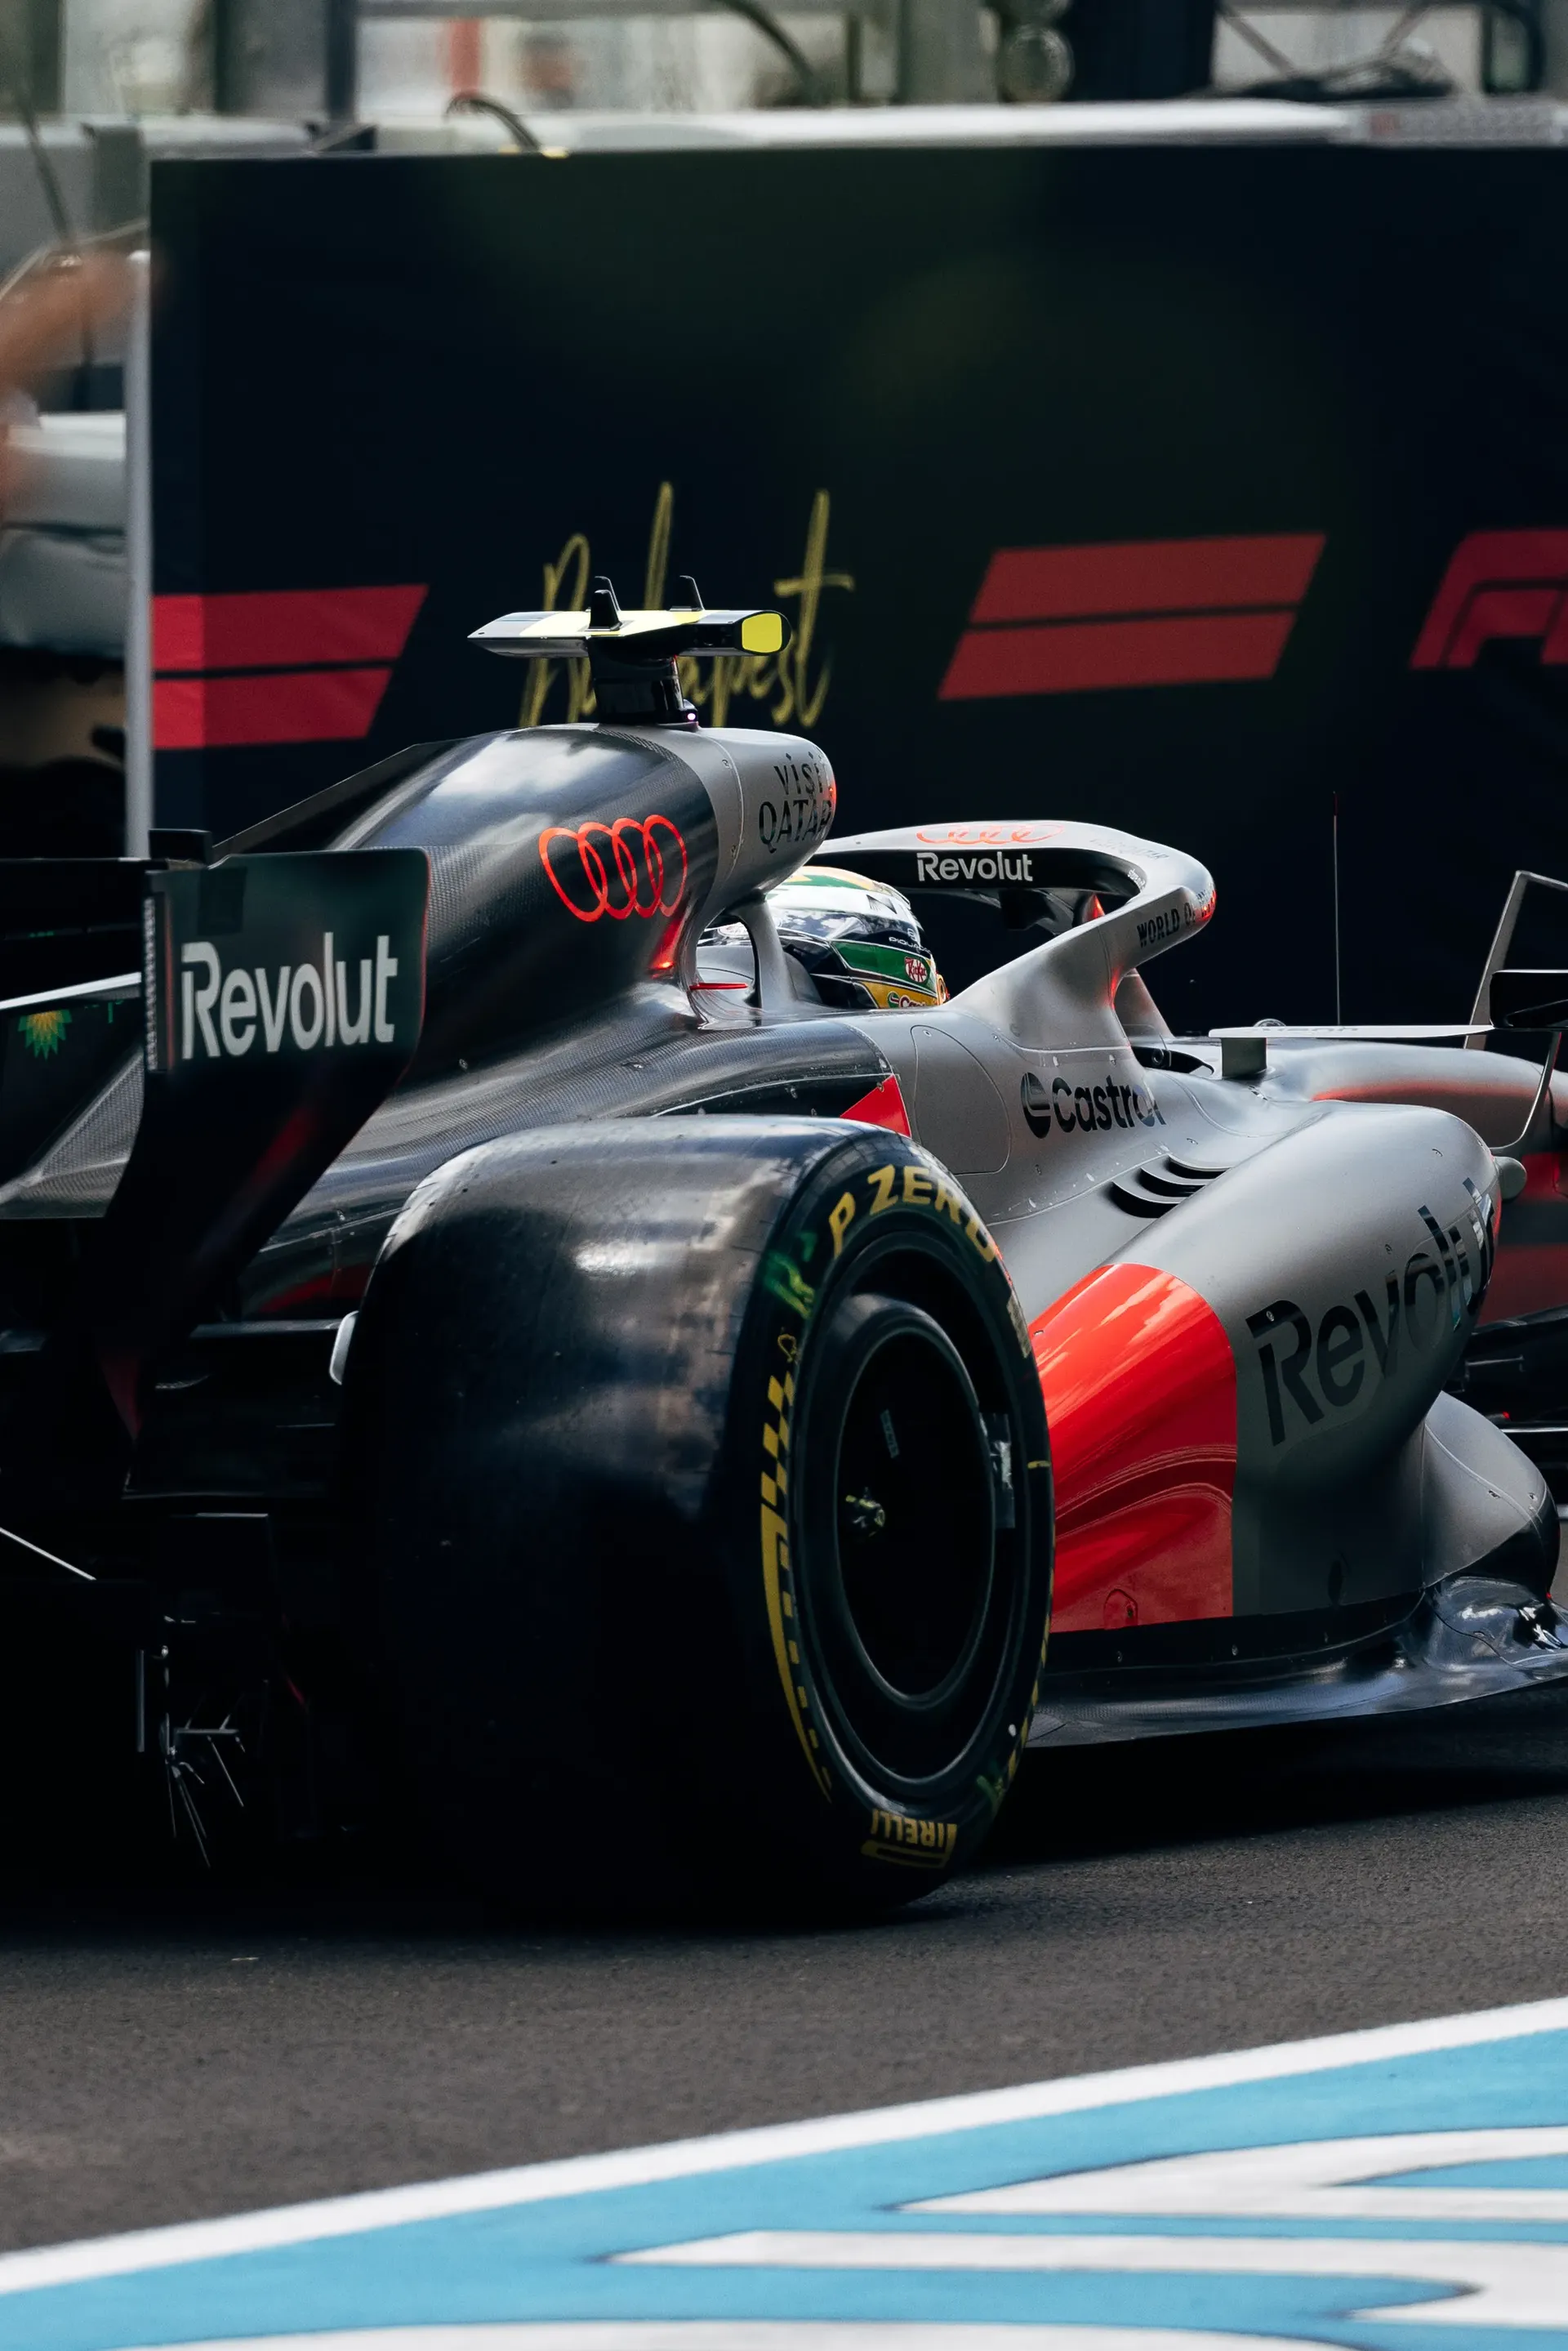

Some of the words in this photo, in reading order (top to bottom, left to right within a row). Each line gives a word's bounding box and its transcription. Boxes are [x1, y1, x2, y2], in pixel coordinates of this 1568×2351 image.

[759, 791, 832, 854] QATAR
[916, 851, 1033, 881] Revolut
[1137, 908, 1180, 948] WORLD
[181, 932, 399, 1060] Revolut
[1052, 1074, 1166, 1133] Castrol
[829, 1192, 856, 1259] P
[867, 1164, 996, 1263] ZERO
[862, 1809, 957, 1867] PIRELLI
